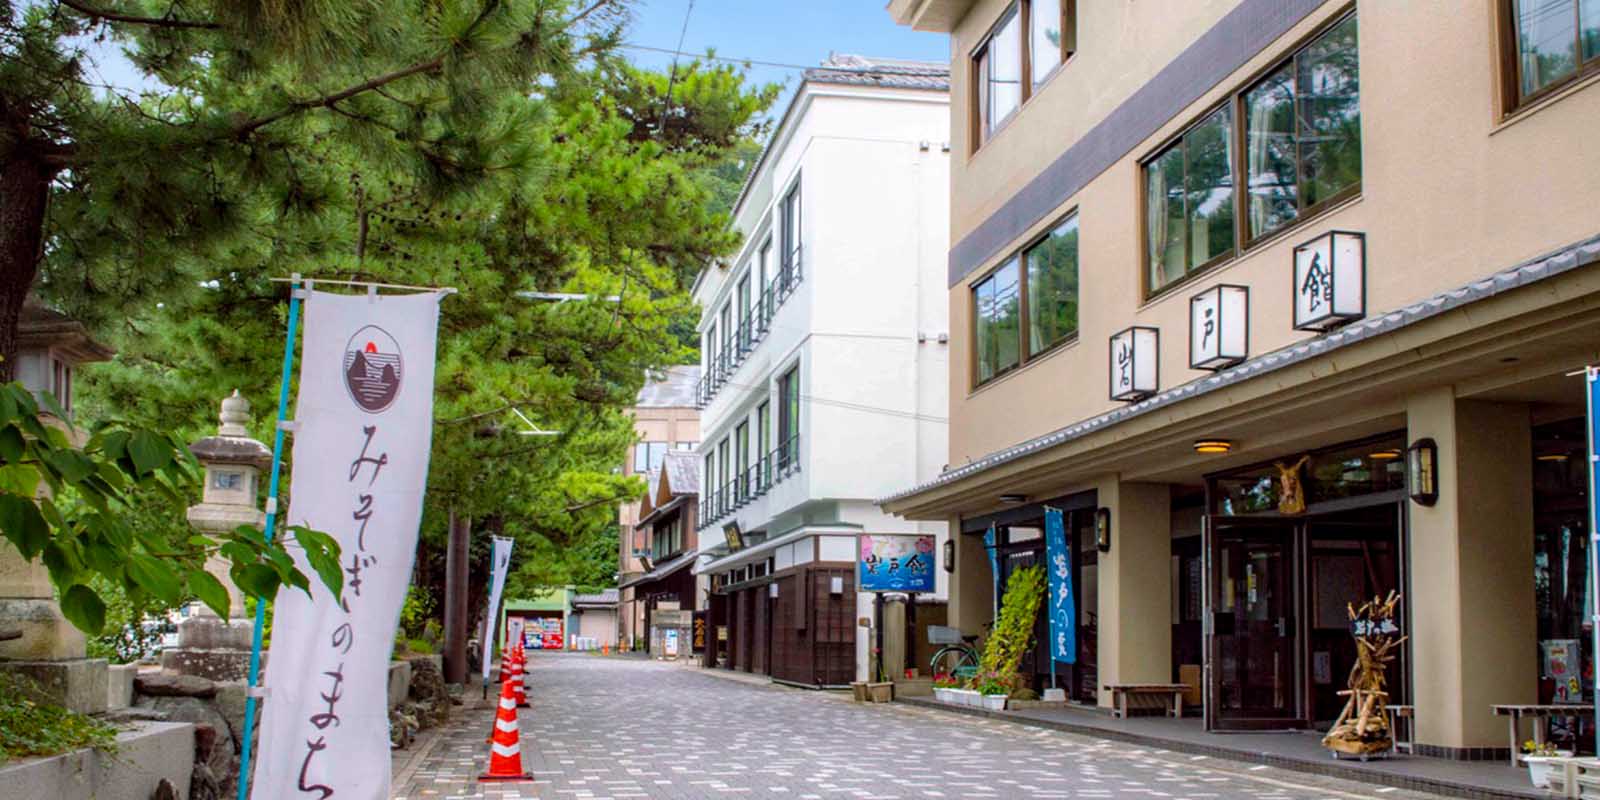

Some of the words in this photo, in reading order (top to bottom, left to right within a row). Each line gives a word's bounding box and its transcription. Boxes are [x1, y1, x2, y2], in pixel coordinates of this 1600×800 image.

[1202, 308, 1214, 350] 戸
[865, 553, 928, 576] 岩戸館
[298, 424, 389, 799] みそぎのまち
